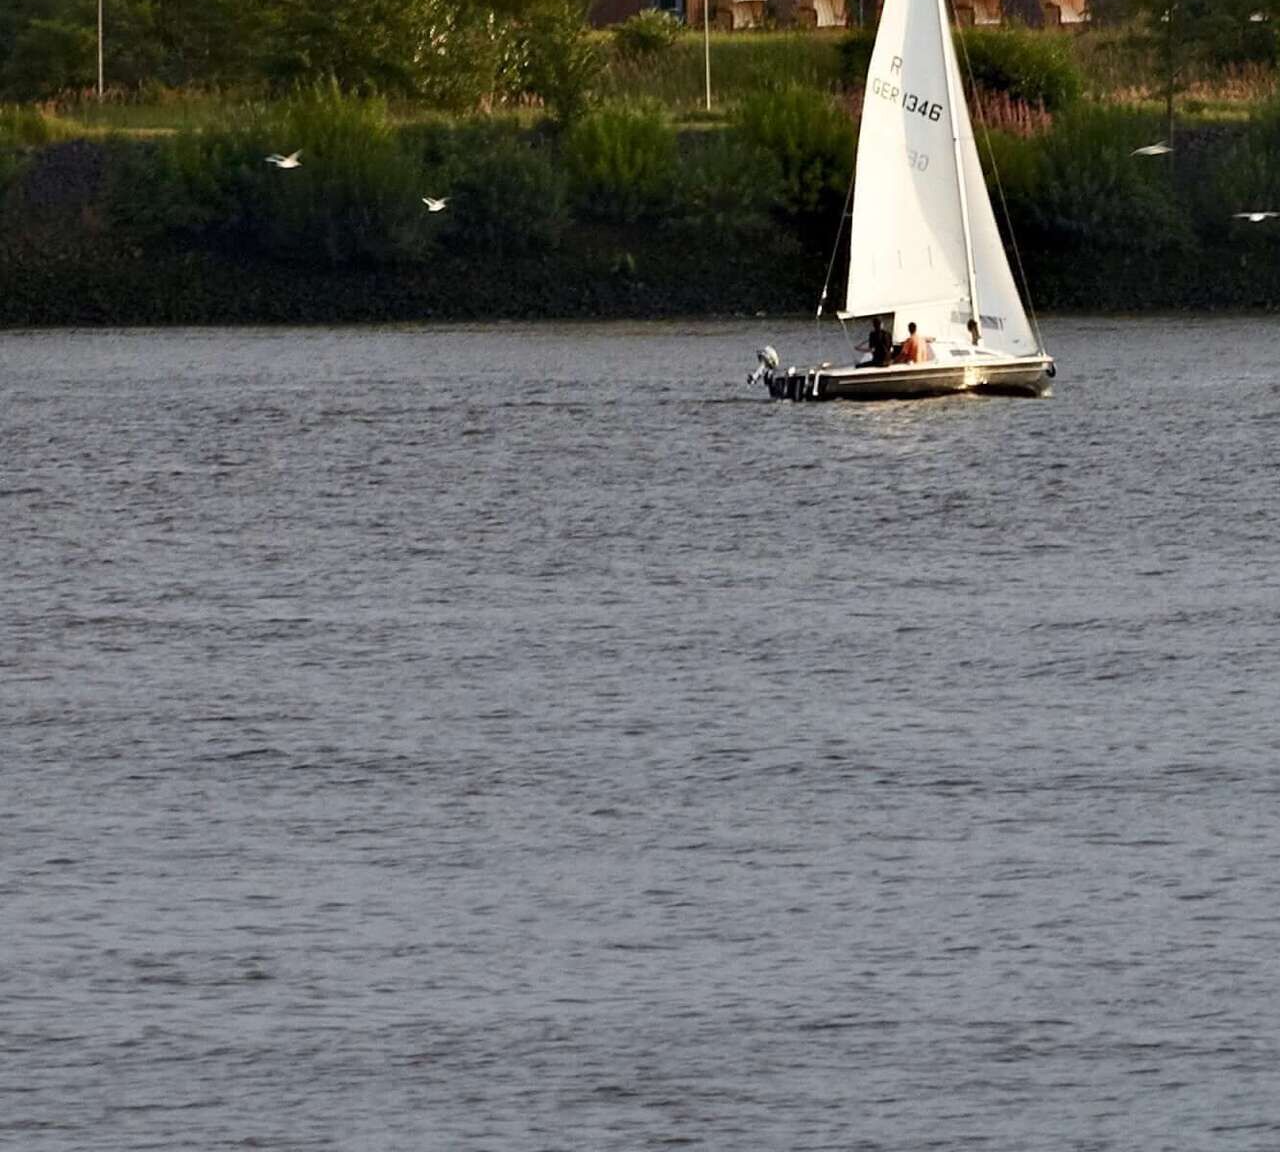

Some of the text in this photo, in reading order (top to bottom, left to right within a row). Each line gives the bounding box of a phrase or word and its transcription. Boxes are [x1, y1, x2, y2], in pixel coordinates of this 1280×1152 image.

[890, 56, 903, 75] R
[872, 78, 943, 122] GER 1346
